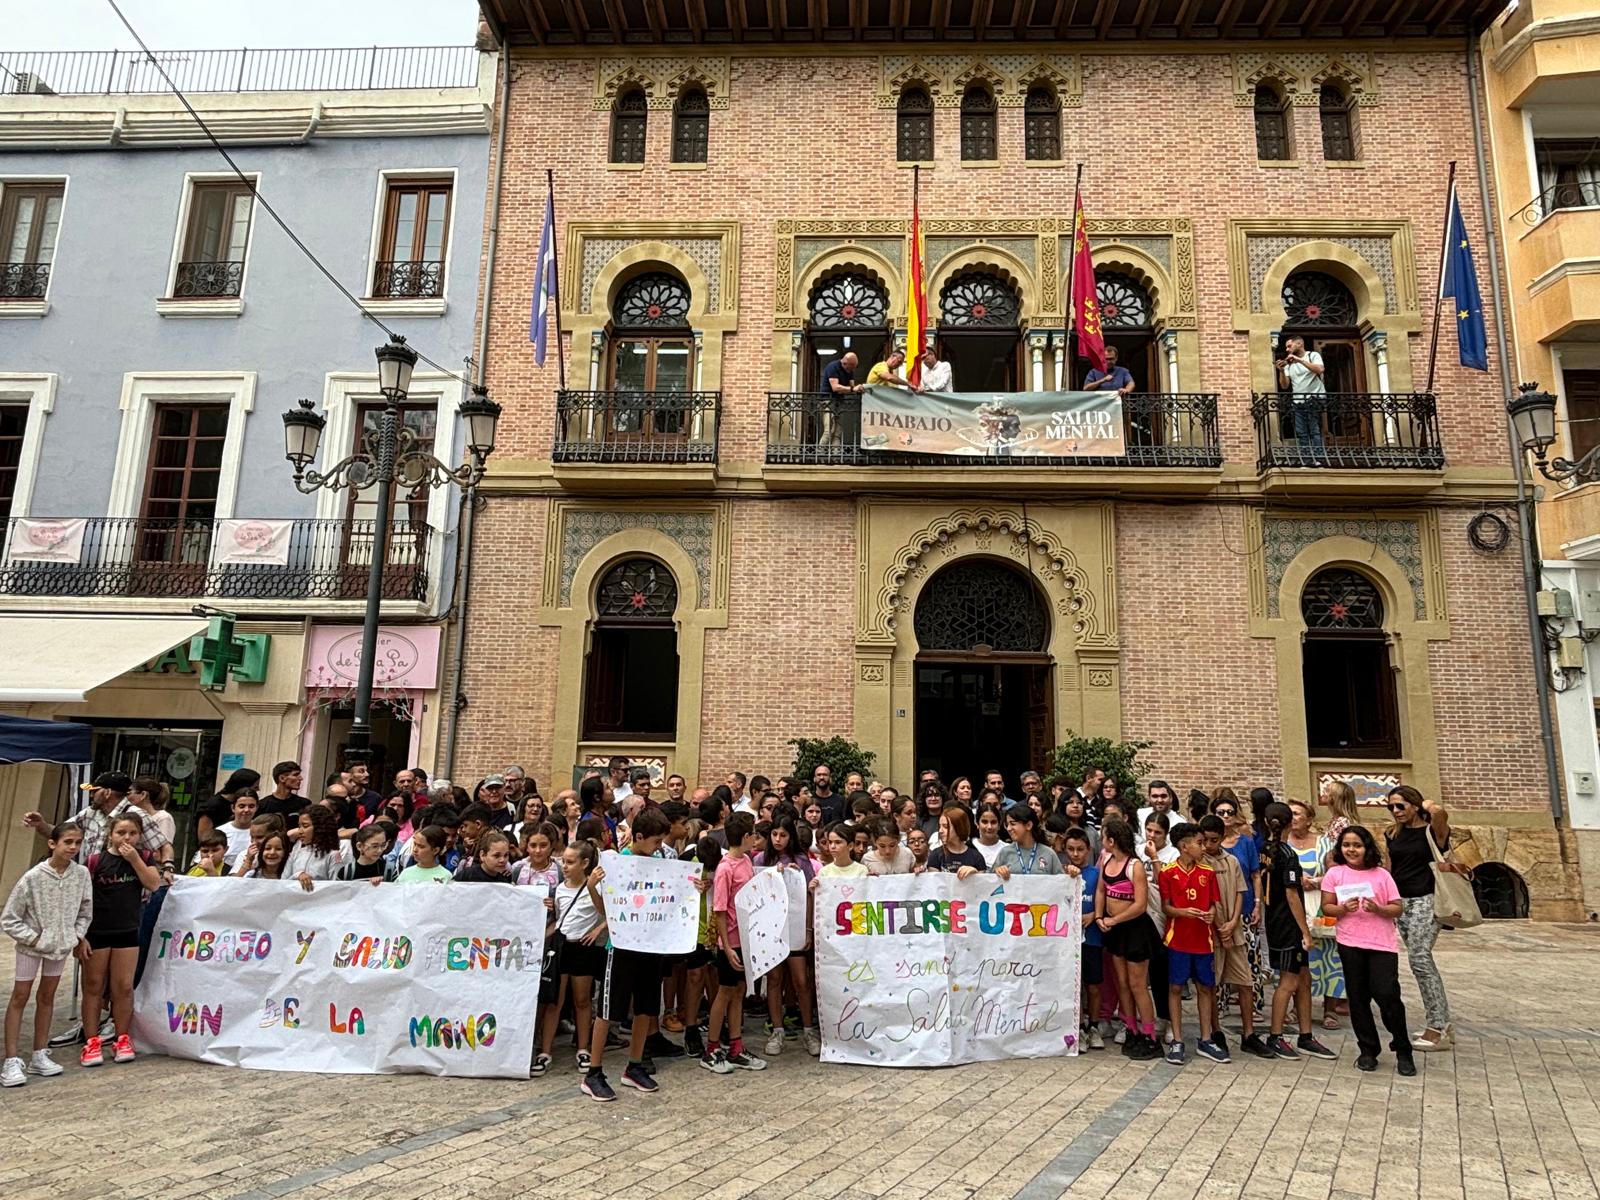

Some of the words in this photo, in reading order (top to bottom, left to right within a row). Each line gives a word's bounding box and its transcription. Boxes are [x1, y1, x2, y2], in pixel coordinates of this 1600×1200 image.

[866, 411, 952, 433] TRABAJO
[1051, 411, 1111, 426] SALUD
[1045, 424, 1119, 440] MENTAL
[650, 895, 676, 905] AYUDA
[1185, 888, 1197, 901] 19
[619, 911, 627, 922] A
[835, 898, 968, 937] SENTIRSE
[978, 884, 1069, 938] ÚTIL
[157, 930, 273, 963] TRABAJO
[295, 930, 316, 965] Y
[332, 931, 414, 970] SALUD
[425, 934, 542, 974] MENTAL
[842, 959, 876, 983] es
[973, 957, 1042, 991] para
[165, 999, 224, 1037] VAN
[258, 997, 301, 1030] DE
[328, 1002, 366, 1036] LA
[408, 1012, 498, 1052] MANO
[834, 996, 878, 1043] la
[971, 992, 1062, 1037] Mental
